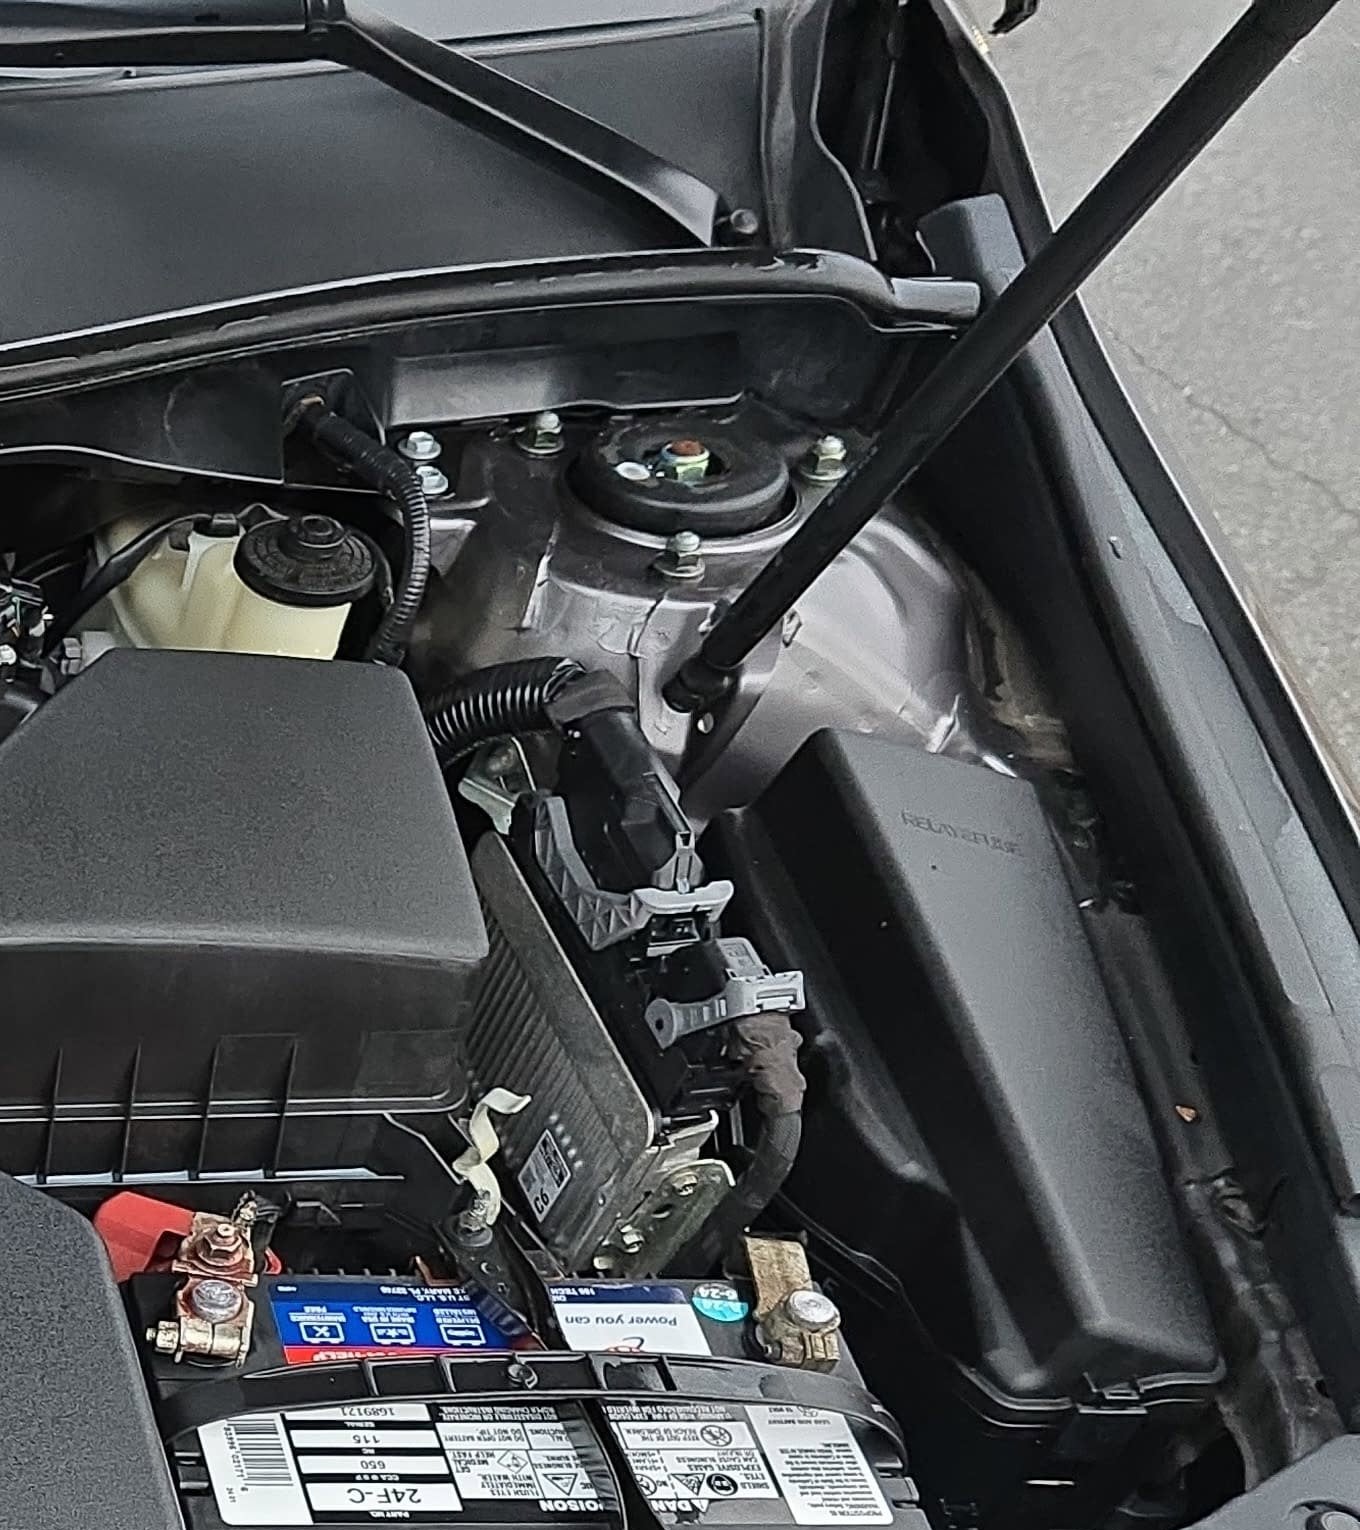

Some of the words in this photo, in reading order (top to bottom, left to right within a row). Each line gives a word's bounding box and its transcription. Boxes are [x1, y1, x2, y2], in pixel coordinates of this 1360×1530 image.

[565, 1316, 590, 1325] can
[594, 1315, 627, 1325] you
[629, 1315, 677, 1326] Power
[352, 1434, 380, 1444] 115
[360, 1460, 386, 1470] 650
[346, 1488, 421, 1504] 24F-C
[537, 1500, 601, 1511] OISON
